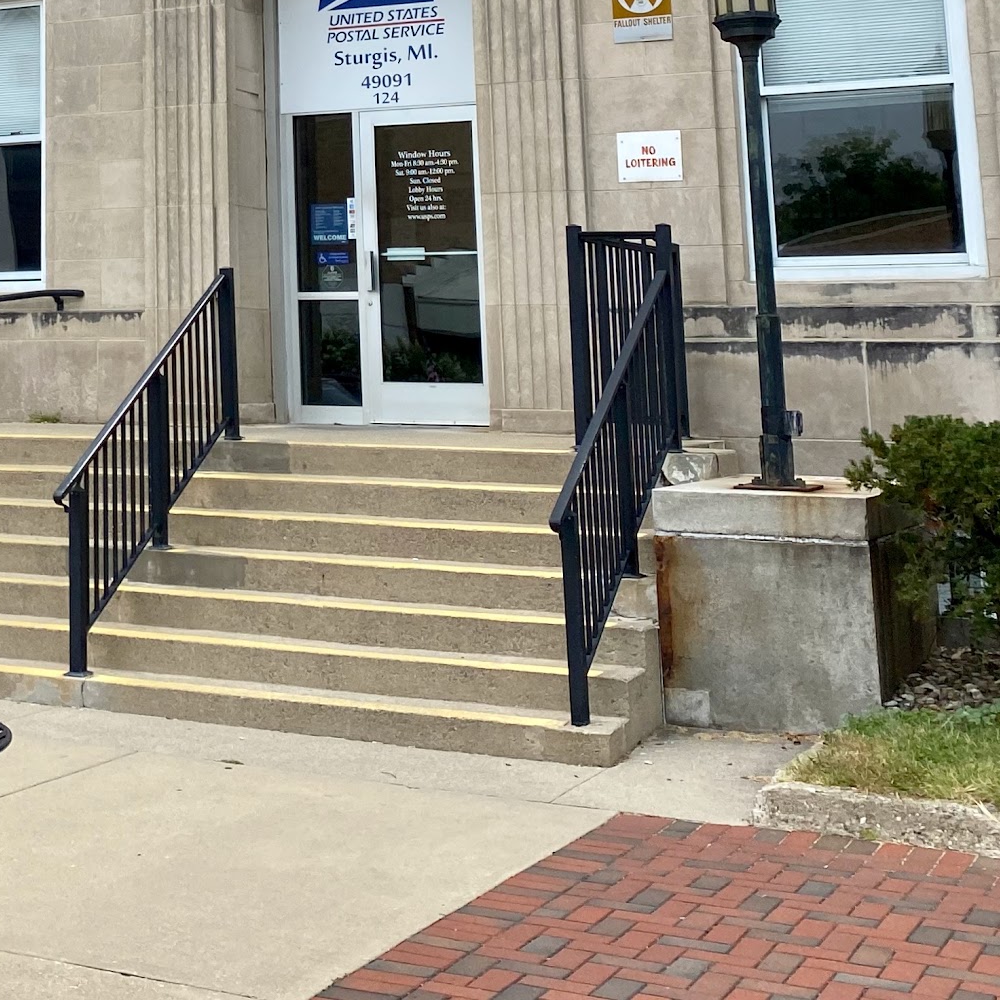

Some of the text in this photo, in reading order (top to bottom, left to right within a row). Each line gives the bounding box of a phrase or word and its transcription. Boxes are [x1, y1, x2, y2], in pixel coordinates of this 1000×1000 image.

[329, 5, 438, 26] UNITED STATES
[614, 16, 671, 28] FALLOUT SHELTER
[327, 22, 445, 43] POSTAL SERVICE
[334, 43, 438, 69] Sturgis, MI.
[361, 73, 411, 89] 49091
[373, 91, 399, 104] 124
[397, 149, 451, 159] Window Hours
[641, 145, 656, 155] NO
[625, 157, 676, 168] LOITERING
[422, 176, 441, 184] Closed
[408, 185, 444, 195] Lobby Hours
[408, 195, 425, 204] Open
[424, 194, 432, 202] 24
